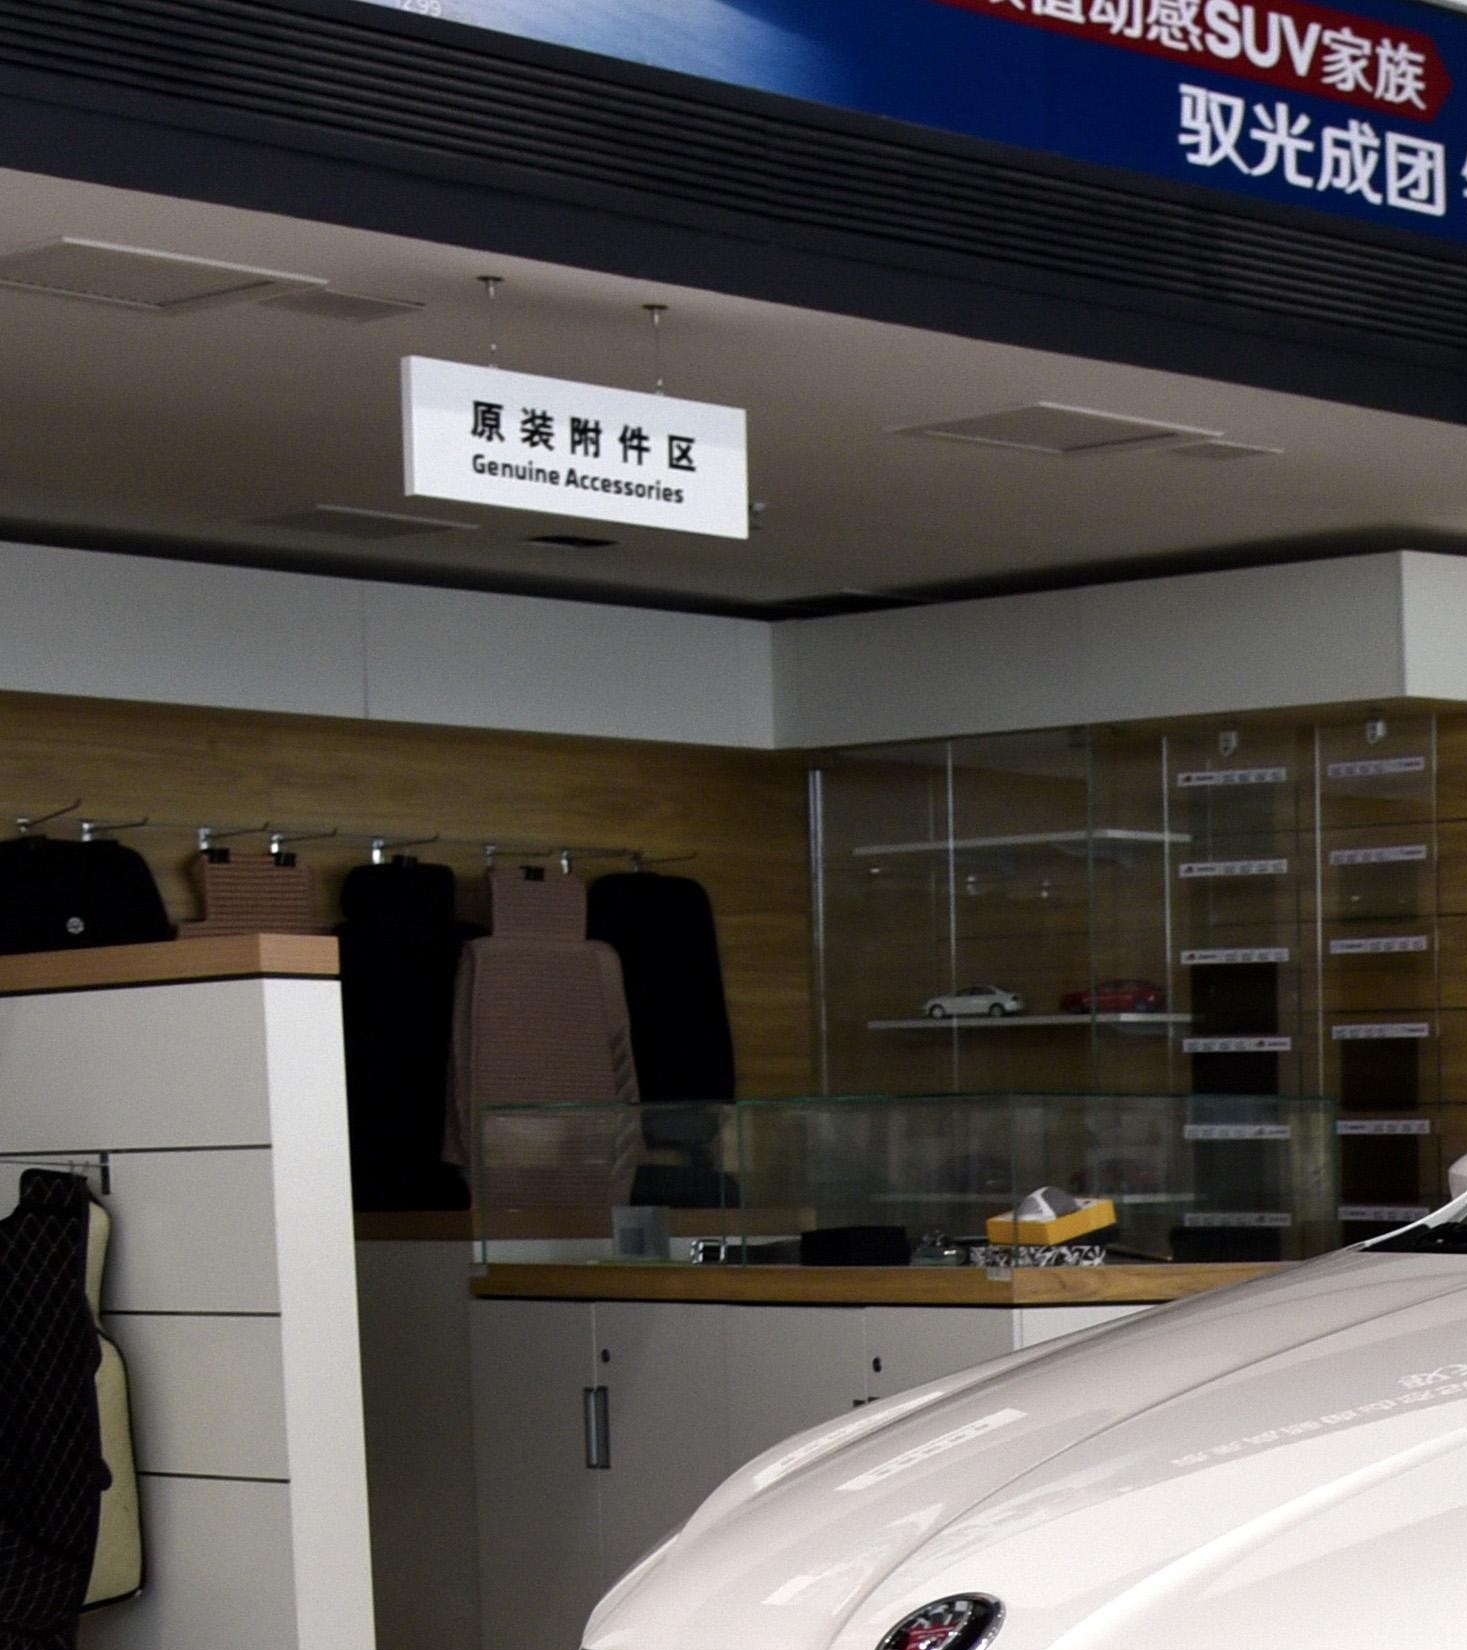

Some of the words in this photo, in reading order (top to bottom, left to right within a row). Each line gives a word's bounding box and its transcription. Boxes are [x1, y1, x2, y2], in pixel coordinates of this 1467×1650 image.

[1178, 83, 1447, 217] 驭光成团
[470, 400, 697, 472] 原装附件区
[472, 453, 560, 486] Genuine
[565, 468, 685, 504] Accessories
